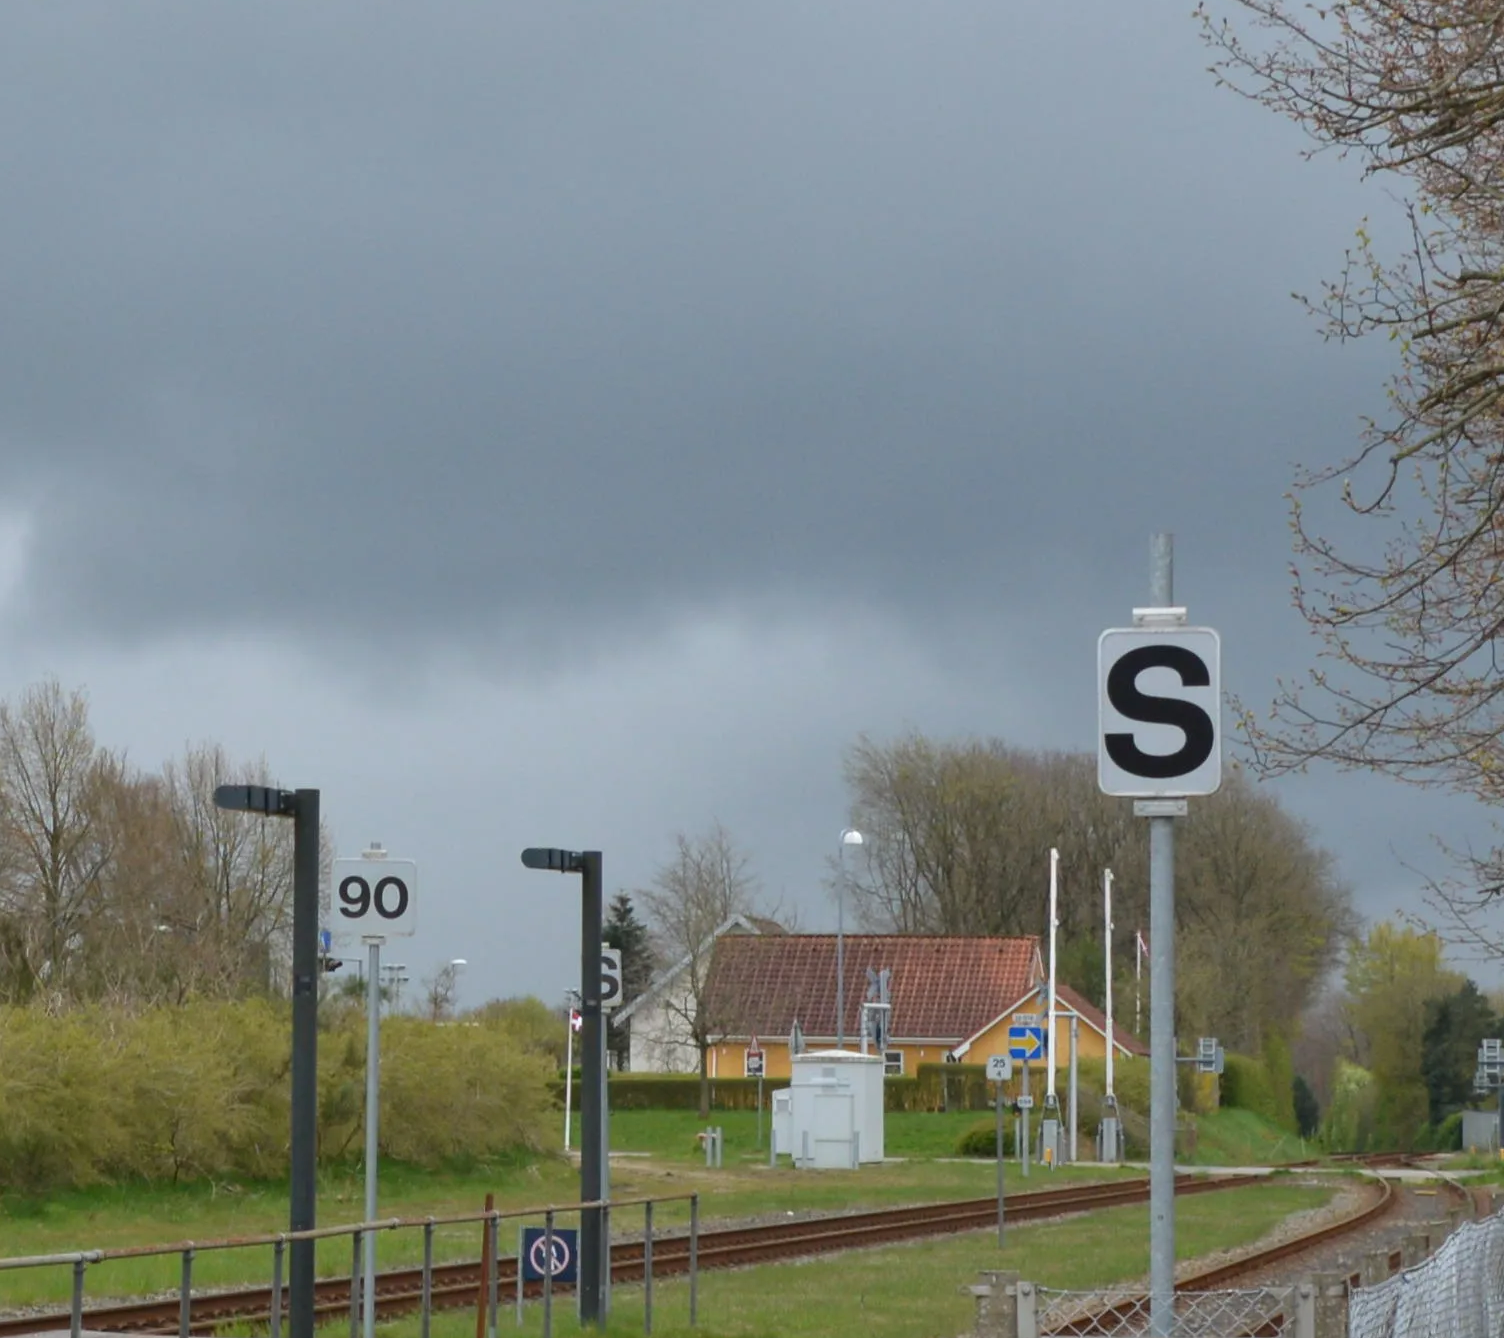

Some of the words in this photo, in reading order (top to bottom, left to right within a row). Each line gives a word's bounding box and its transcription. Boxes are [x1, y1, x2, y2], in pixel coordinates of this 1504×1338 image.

[1104, 644, 1215, 779] S
[338, 875, 409, 920] 90
[992, 1058, 1006, 1069] 25
